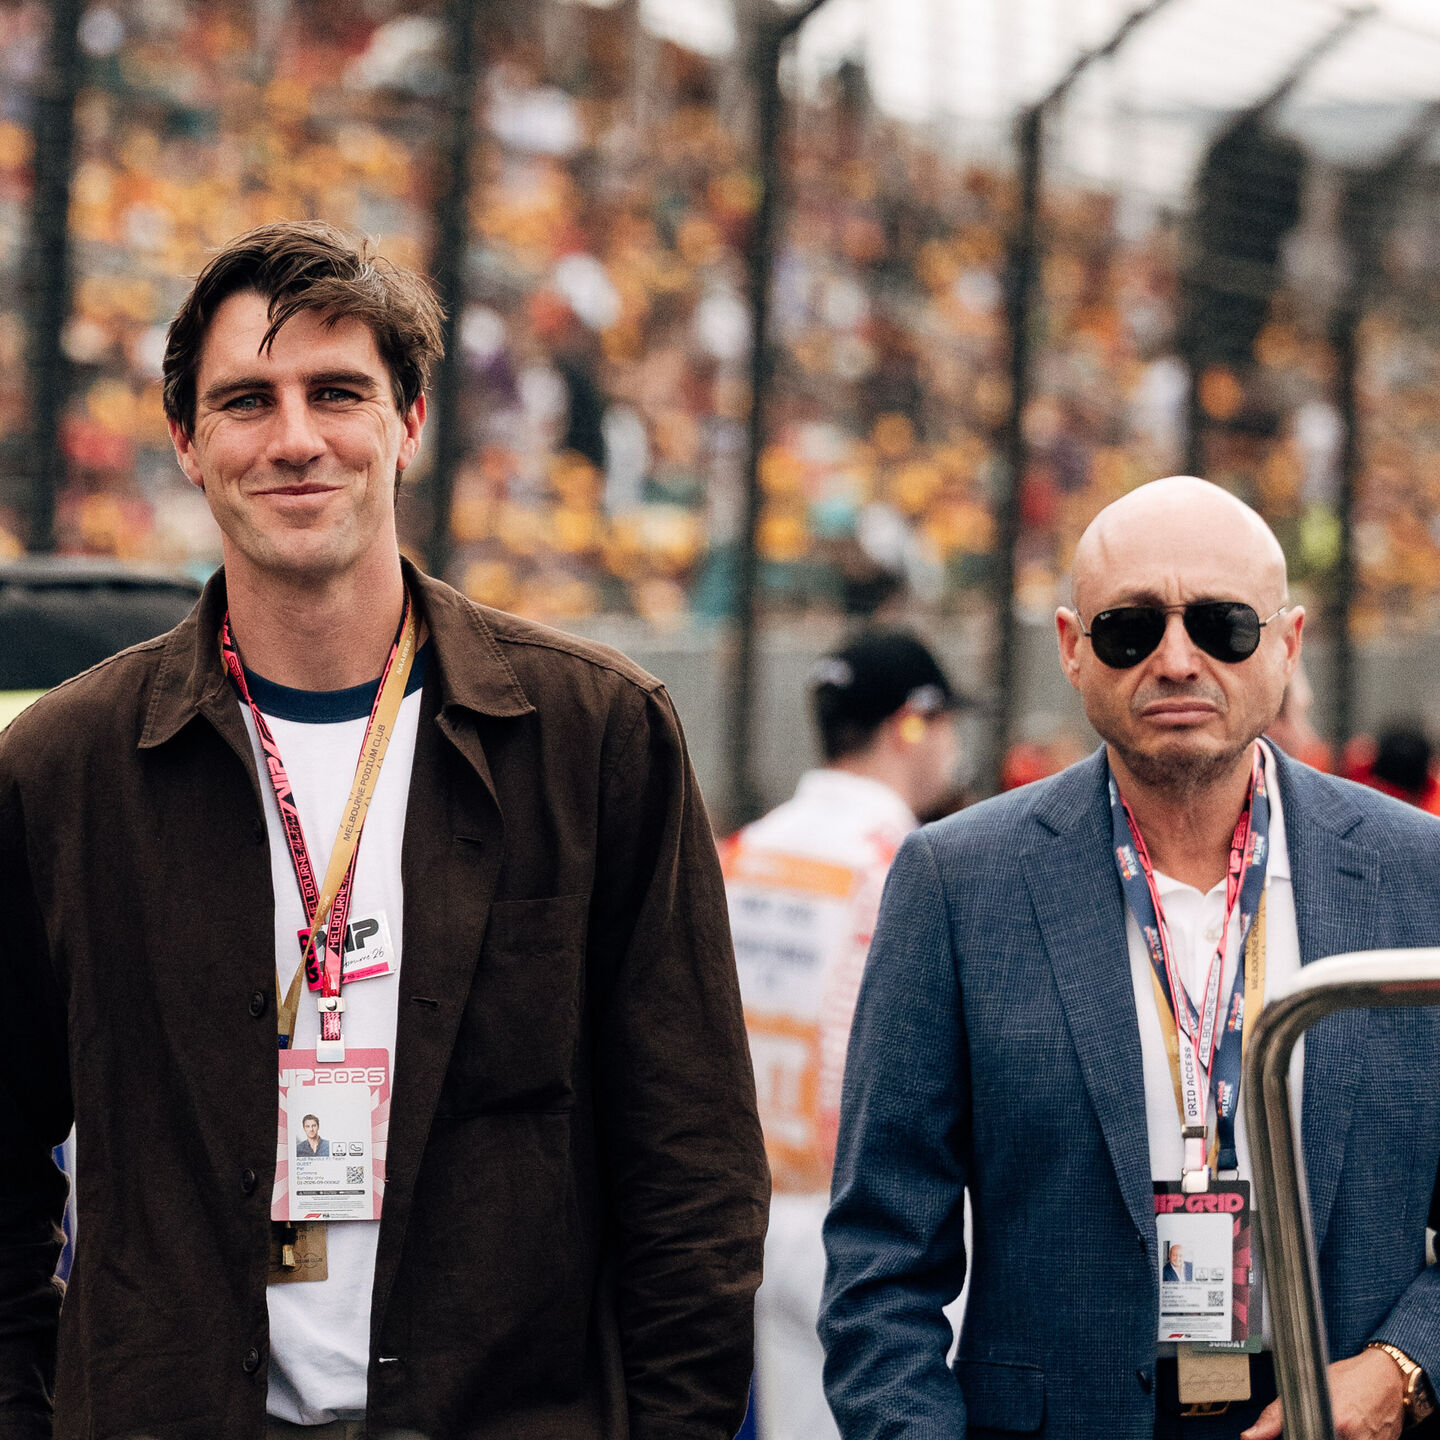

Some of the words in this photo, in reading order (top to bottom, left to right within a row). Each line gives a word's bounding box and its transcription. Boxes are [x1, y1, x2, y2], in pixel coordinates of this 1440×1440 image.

[343, 786, 366, 842] MELBOURNE
[360, 748, 378, 786] PODIUM
[372, 724, 386, 749] CLUB
[330, 885, 348, 949] MELBOURNE
[1184, 1046, 1196, 1087] ACCESS
[1186, 1091, 1197, 1117] GRID
[1185, 1192, 1245, 1213] GRID
